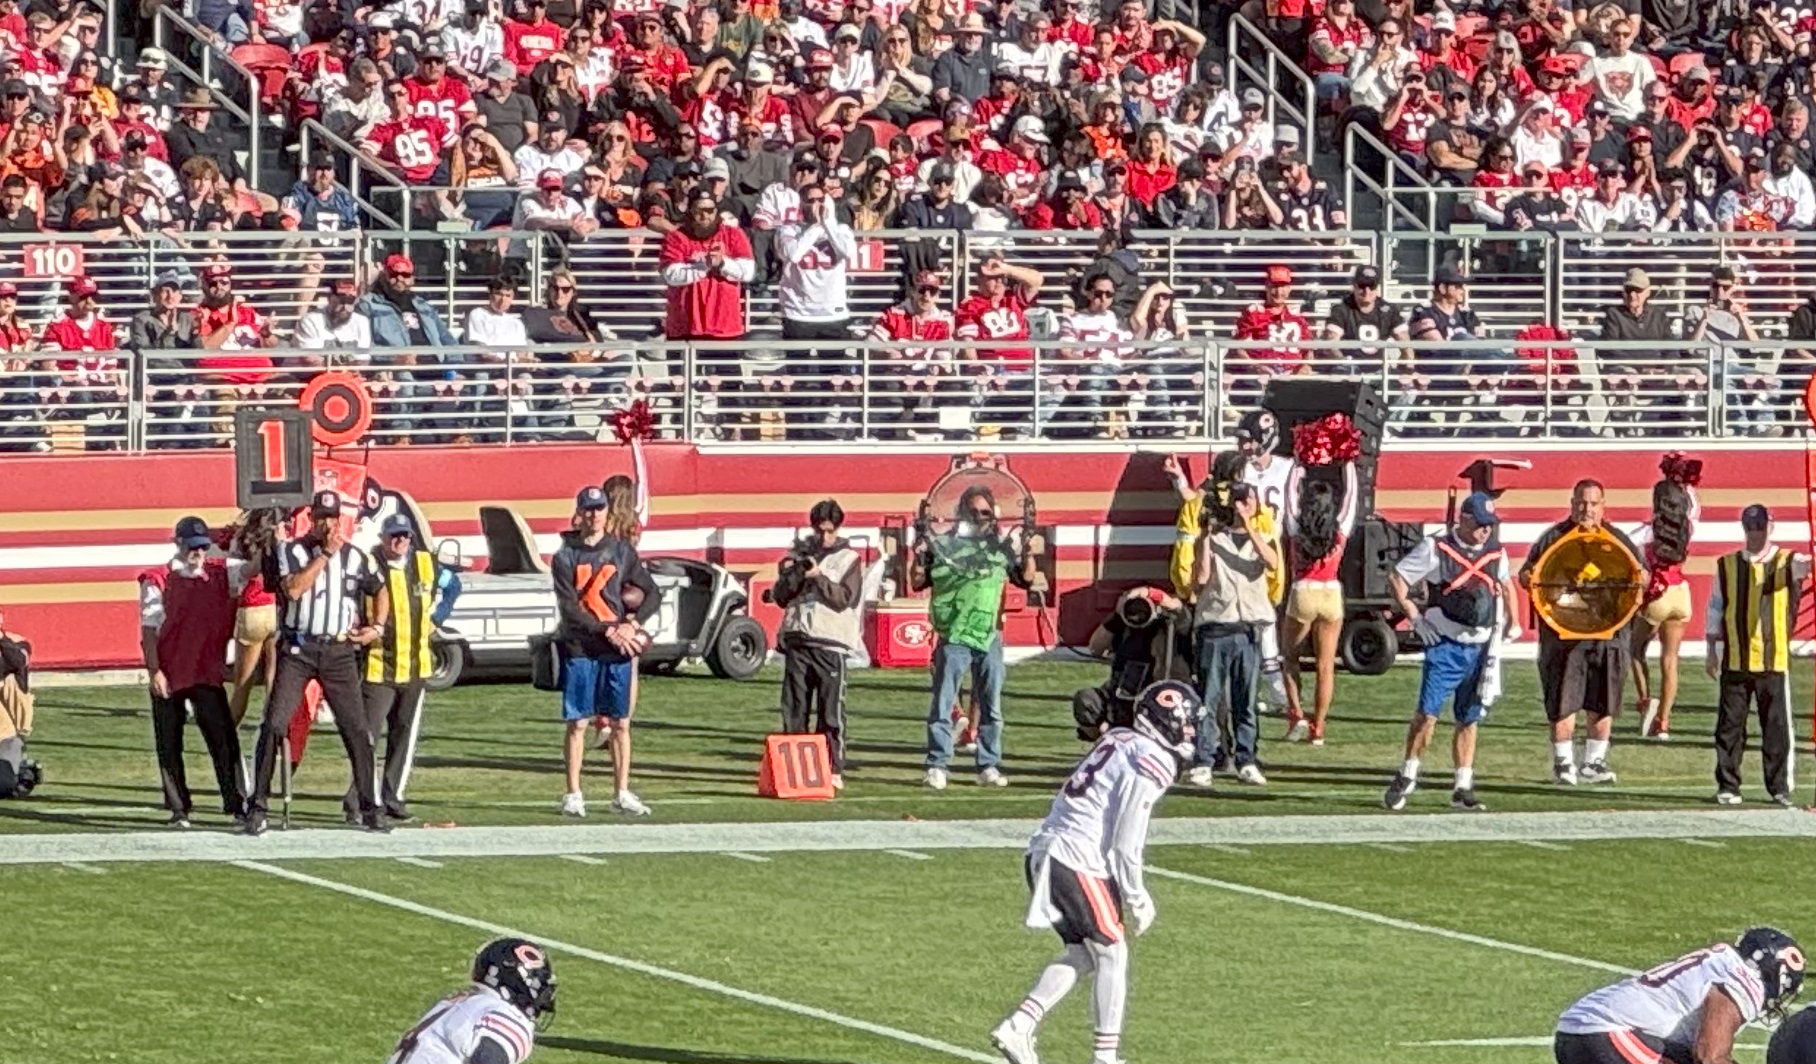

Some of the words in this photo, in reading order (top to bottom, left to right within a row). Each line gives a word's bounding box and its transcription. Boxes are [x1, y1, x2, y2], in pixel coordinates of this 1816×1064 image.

[396, 129, 434, 168] 95
[33, 248, 76, 275] 110
[257, 420, 287, 482] 1
[778, 742, 825, 789] 10
